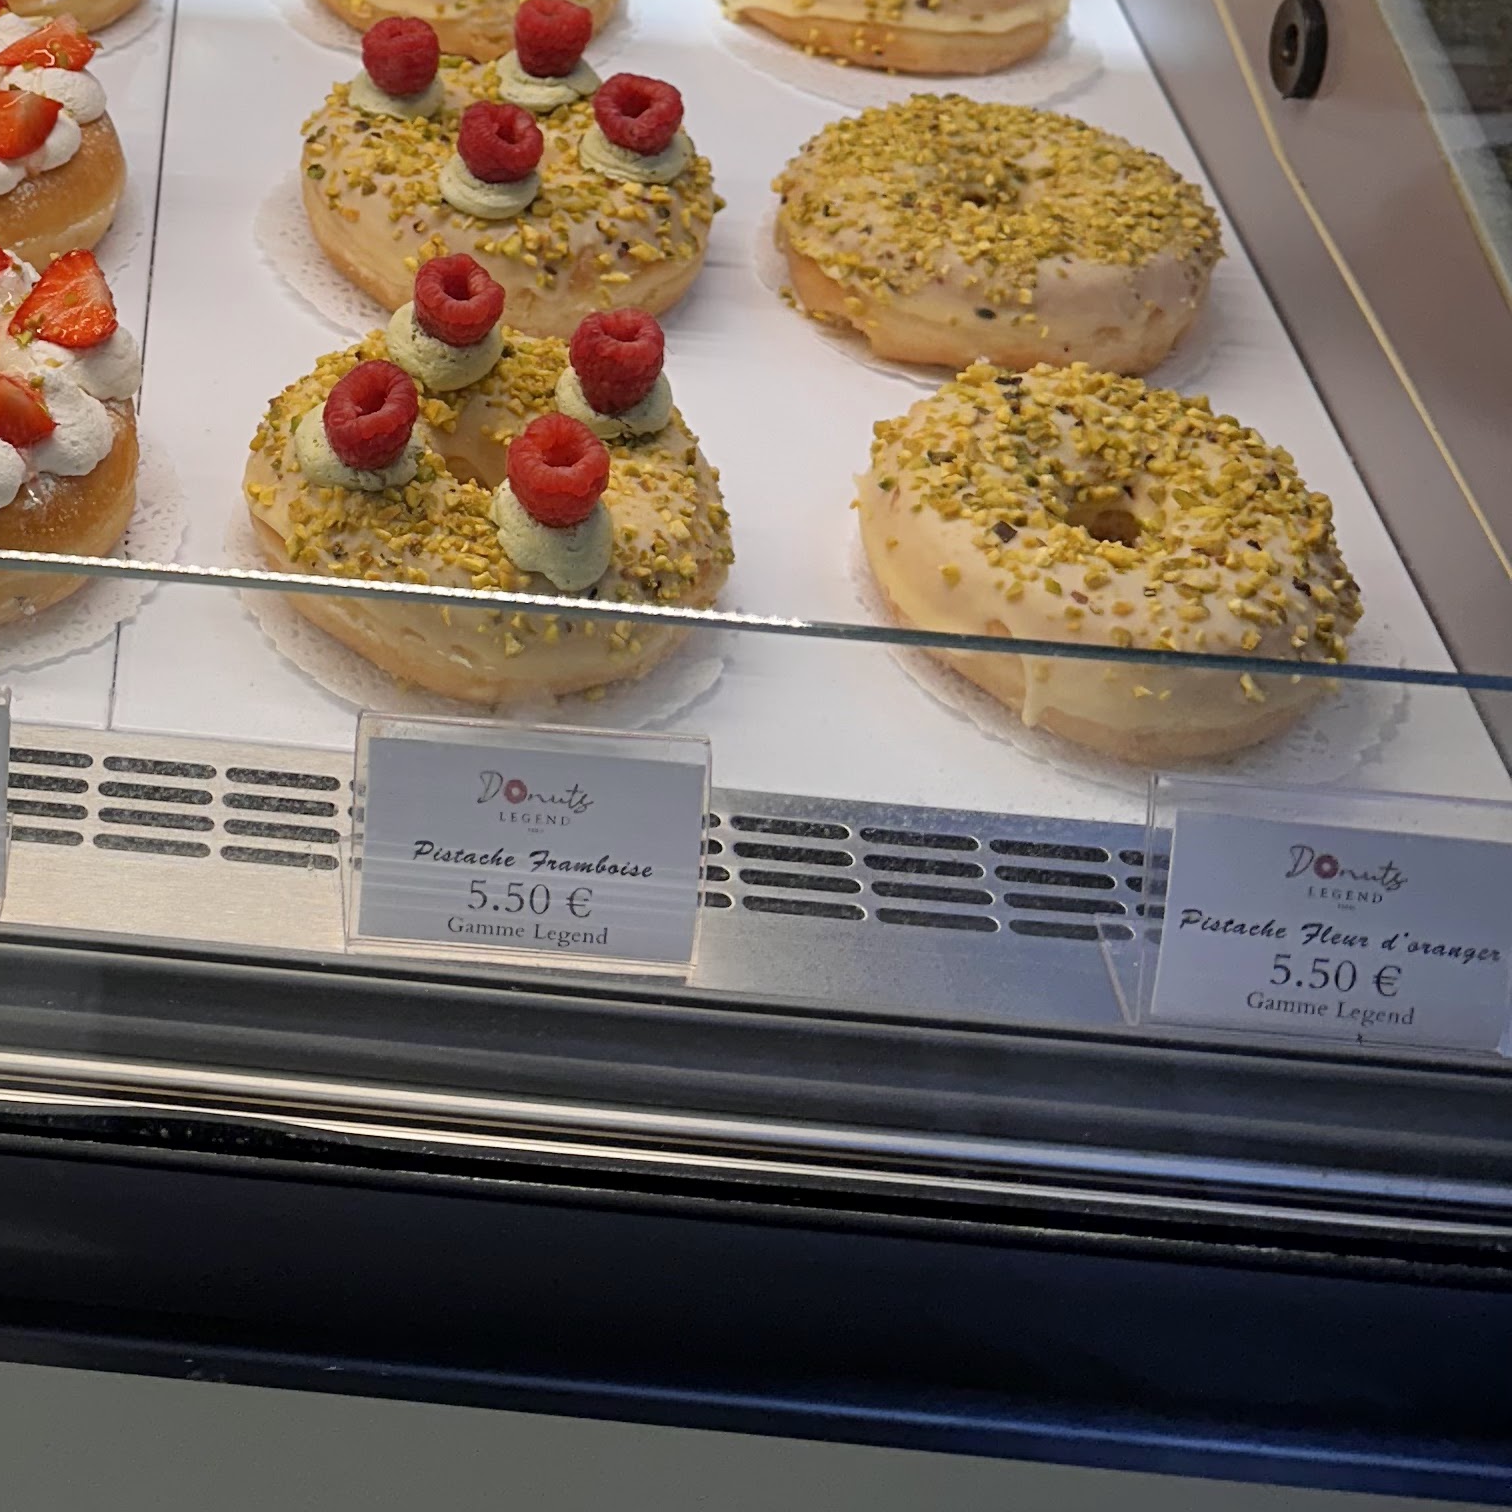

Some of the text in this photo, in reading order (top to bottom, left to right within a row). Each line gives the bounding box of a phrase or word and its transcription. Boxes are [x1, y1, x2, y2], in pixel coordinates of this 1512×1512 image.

[499, 812, 571, 826] LEGEND
[413, 840, 653, 878] Pistache Framboise
[467, 880, 593, 918] 5.50 €
[1308, 886, 1383, 903] LEGEND
[447, 916, 608, 947] Gamme Legend
[1179, 909, 1501, 965] Pistache Fleur d'oranger
[1270, 953, 1402, 997] 5.50 €
[1246, 991, 1415, 1026] Gamme Legend
